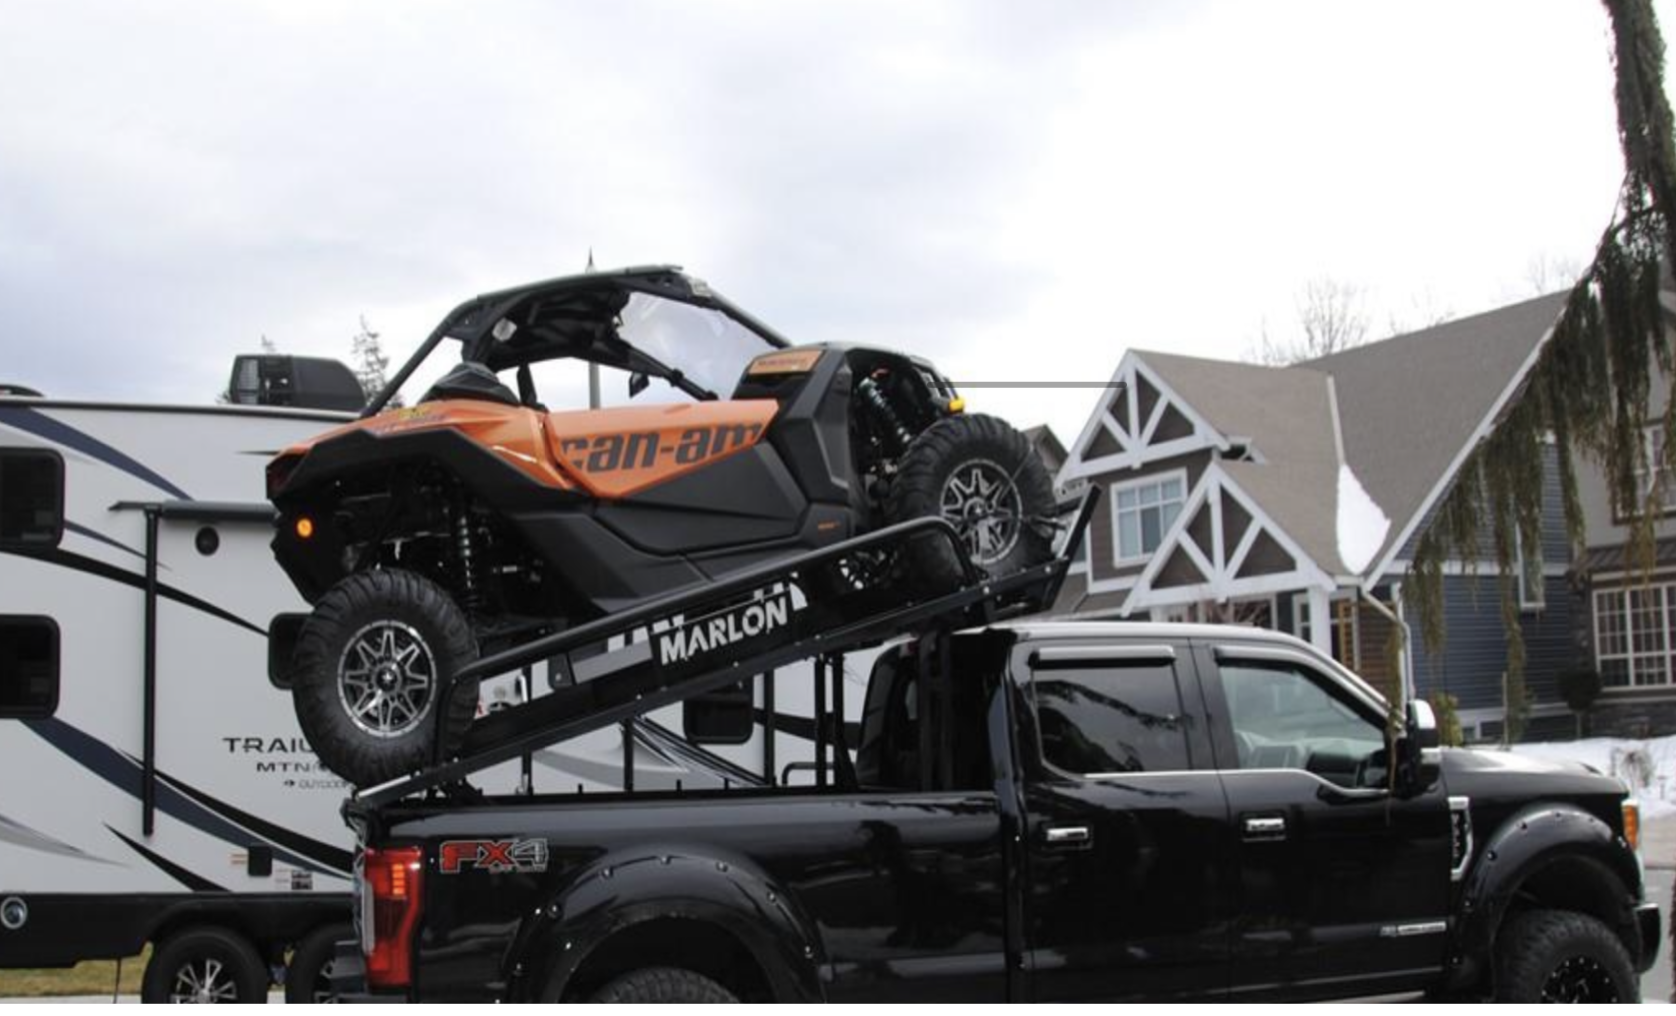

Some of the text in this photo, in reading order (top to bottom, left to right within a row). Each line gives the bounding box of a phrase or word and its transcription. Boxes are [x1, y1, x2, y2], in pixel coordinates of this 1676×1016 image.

[561, 422, 762, 473] can-am
[659, 596, 788, 666] MARLON
[440, 838, 549, 874] FX4
